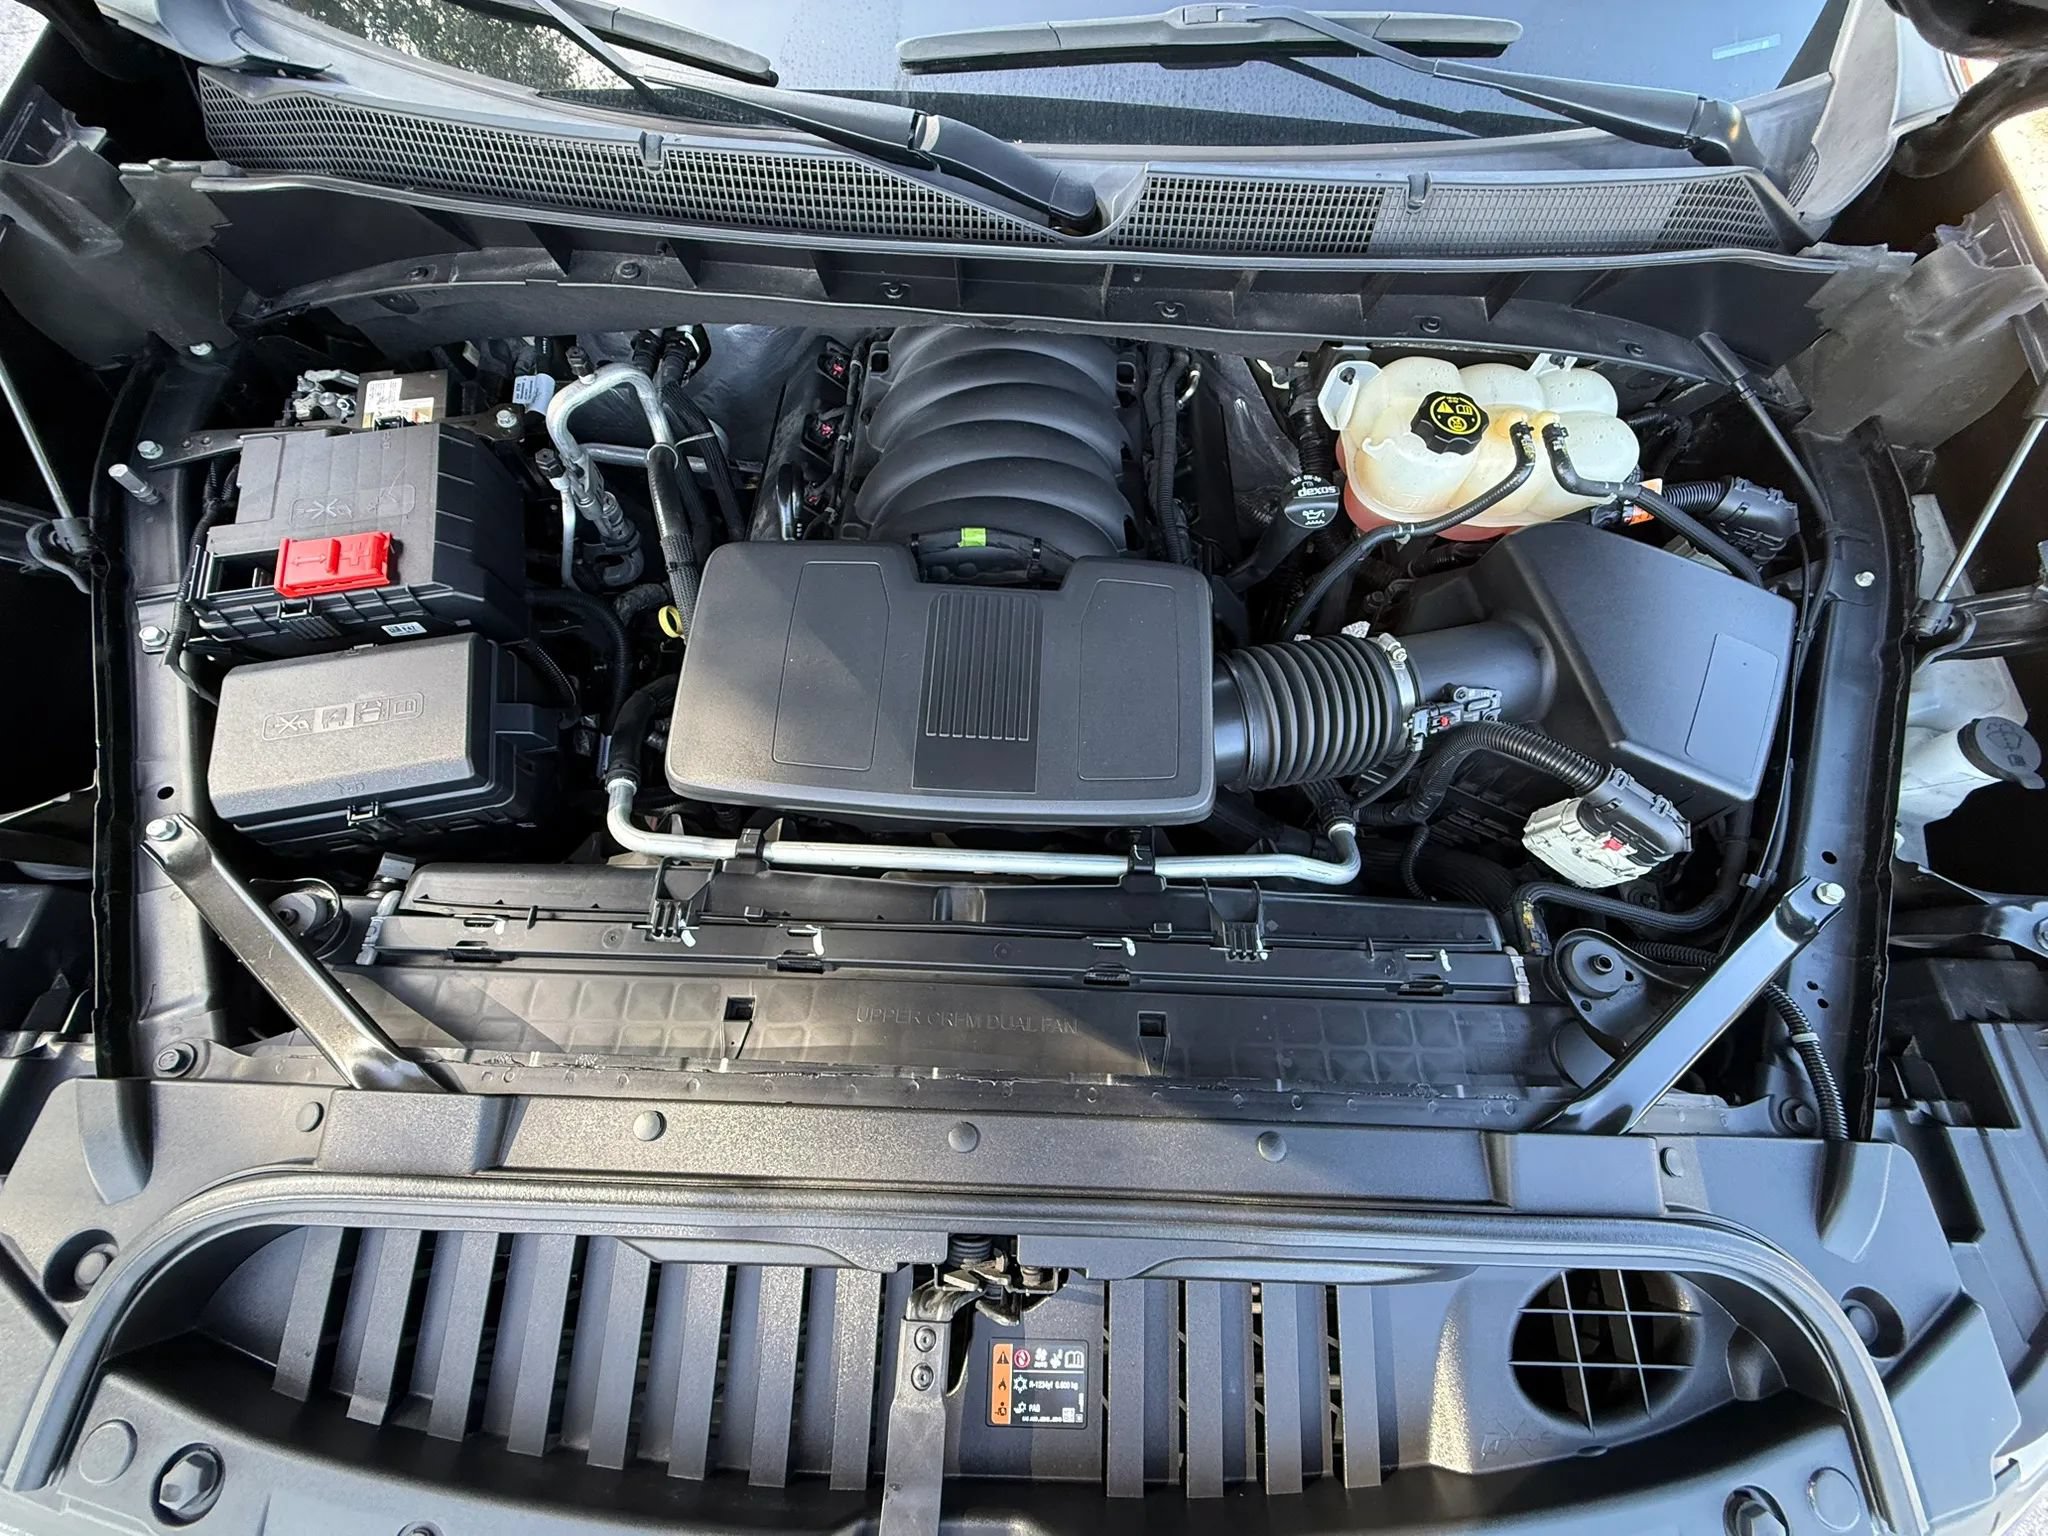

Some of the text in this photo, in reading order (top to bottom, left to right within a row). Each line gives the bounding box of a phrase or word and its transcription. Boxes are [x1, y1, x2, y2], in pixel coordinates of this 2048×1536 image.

[1297, 486, 1337, 497] dexos
[856, 1007, 921, 1024] UPPER
[986, 1014, 1038, 1032] DUAL
[1041, 1016, 1079, 1034] FAN
